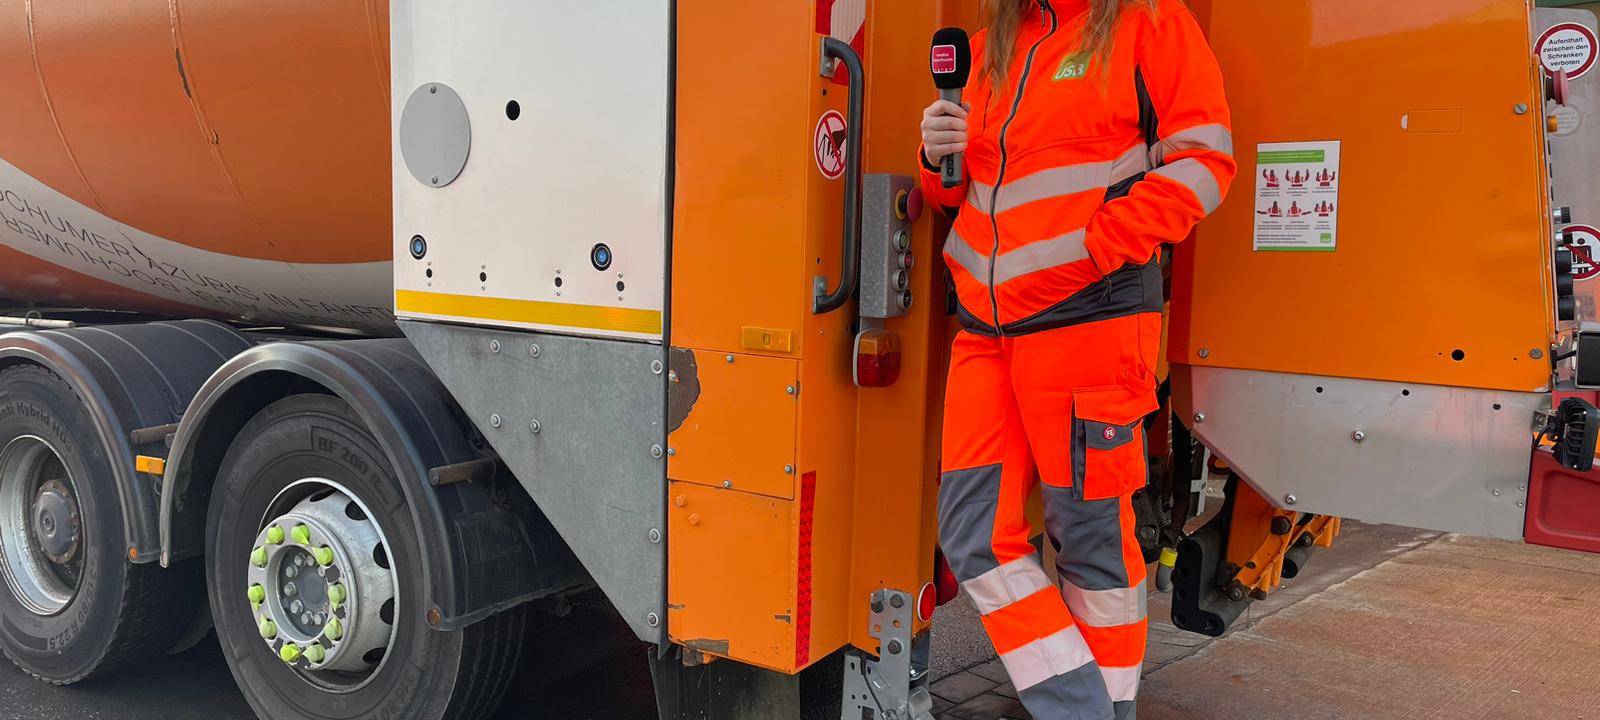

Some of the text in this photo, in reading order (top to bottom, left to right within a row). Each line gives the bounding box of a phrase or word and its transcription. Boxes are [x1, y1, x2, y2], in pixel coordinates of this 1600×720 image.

[1548, 37, 1583, 45] Aufenthalt
[1542, 45, 1574, 53] zwischen
[1547, 52, 1583, 60] Schranken
[0, 189, 136, 263] CHUMER
[147, 257, 259, 301] AZUBIS
